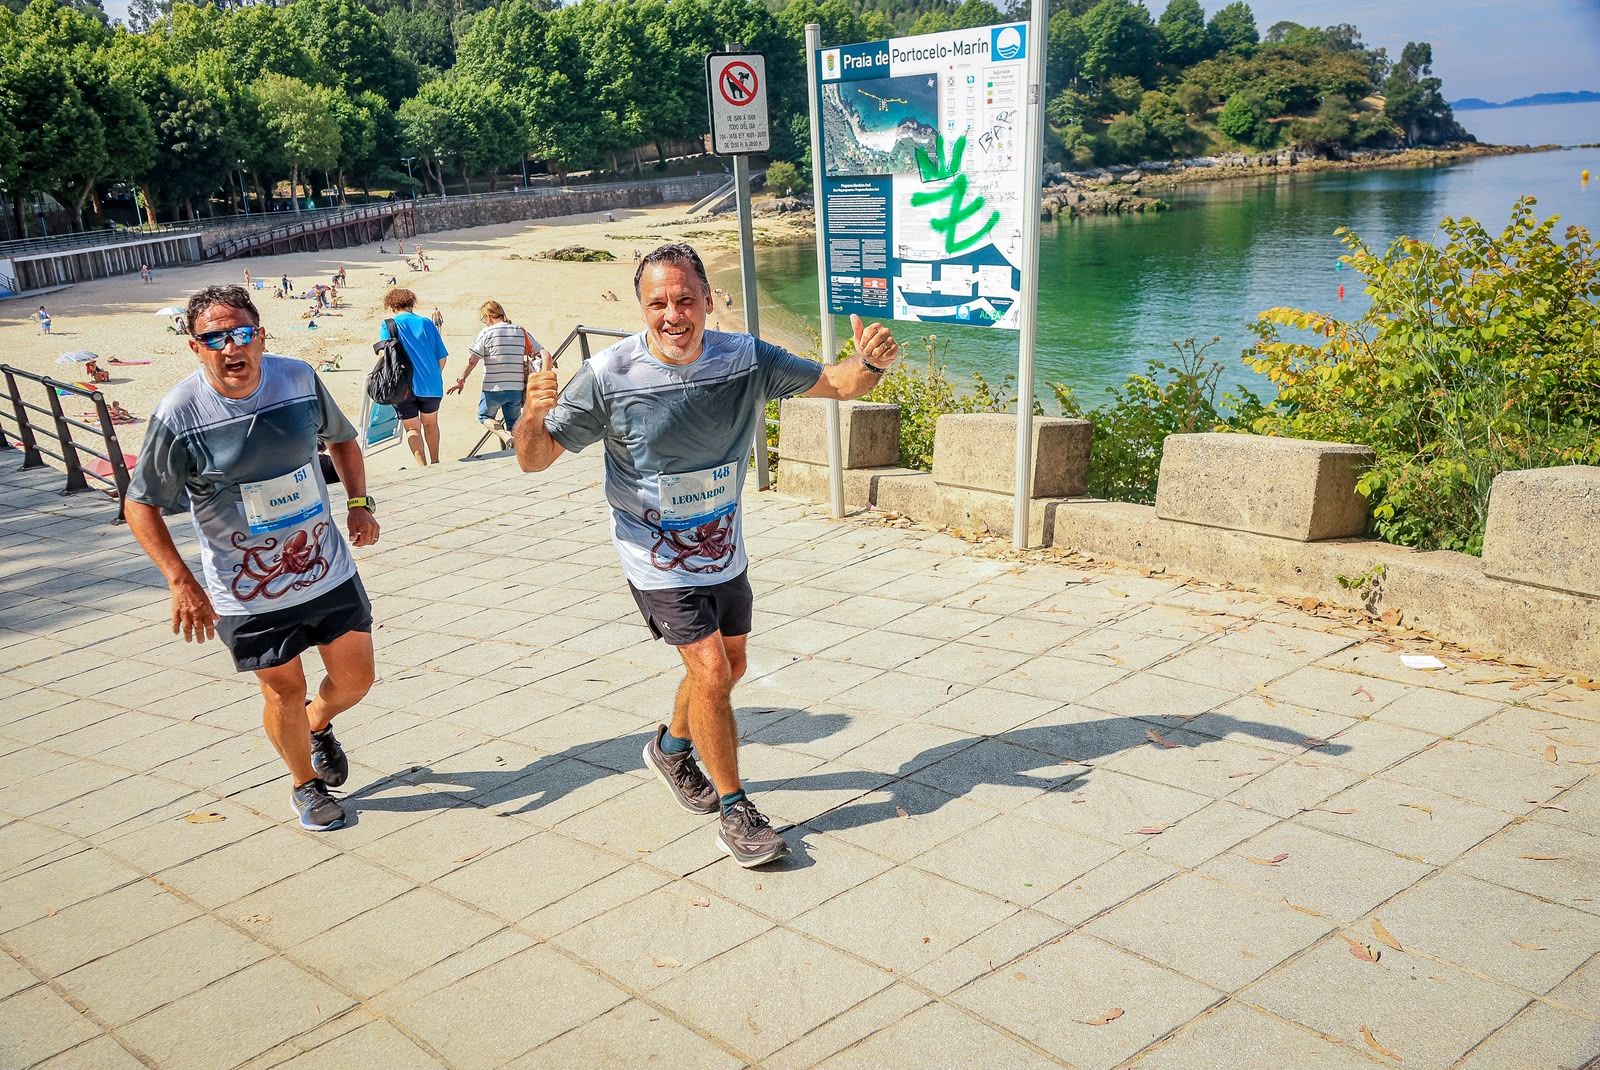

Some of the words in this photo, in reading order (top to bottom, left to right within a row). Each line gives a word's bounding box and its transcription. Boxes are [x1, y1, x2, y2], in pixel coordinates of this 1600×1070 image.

[843, 53, 873, 70] Praia
[875, 50, 890, 67] de
[892, 38, 989, 64] Portocelo-Marín
[980, 310, 1006, 320] ADEA
[293, 468, 308, 484] 151
[712, 466, 730, 481] 148
[269, 492, 300, 507] OMAR
[672, 485, 725, 505] LEONARDO
